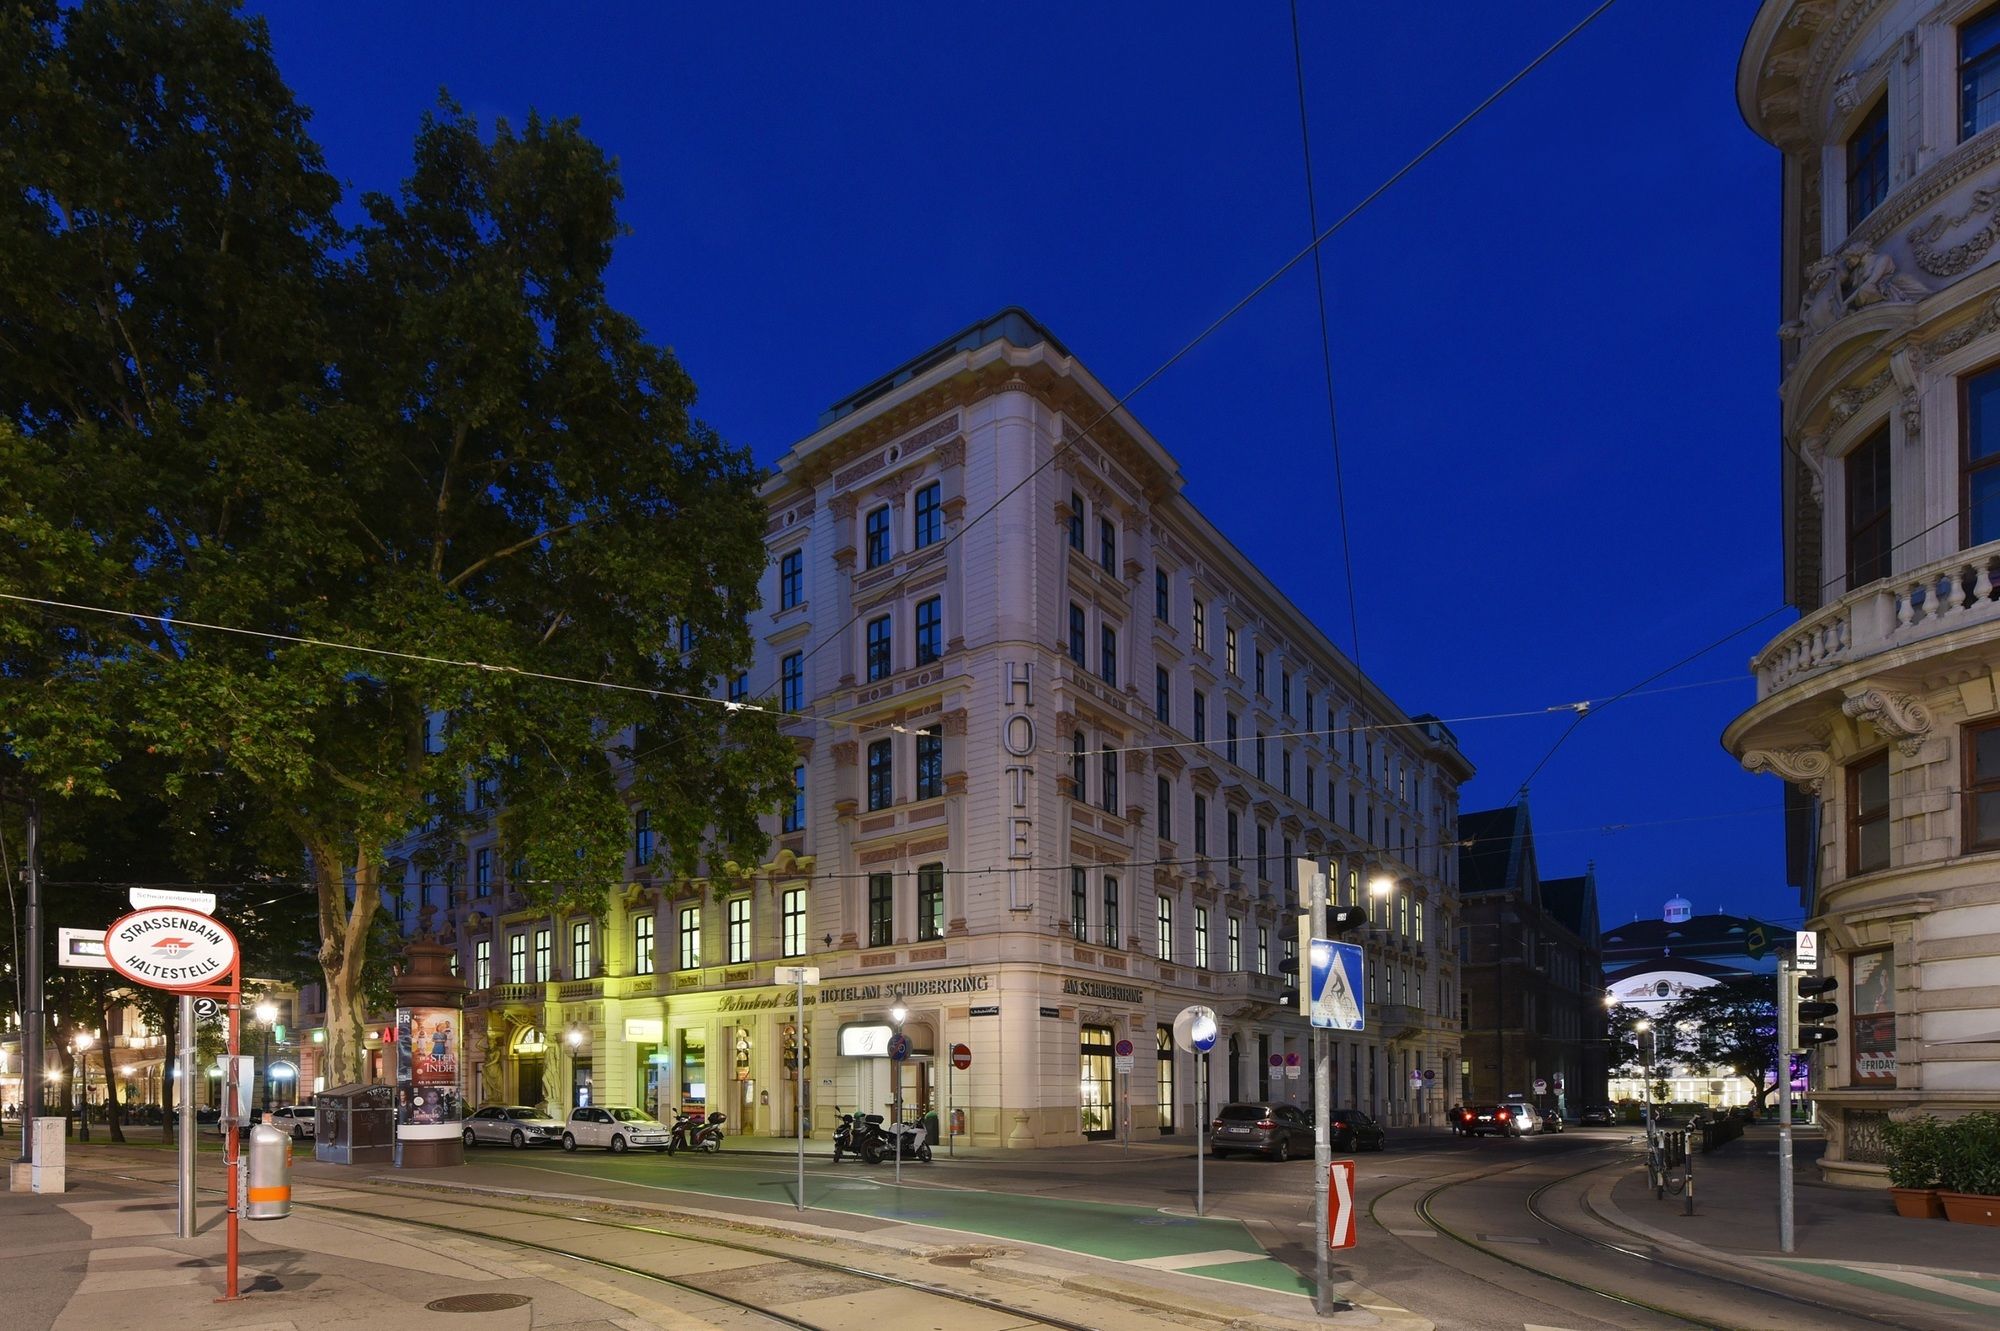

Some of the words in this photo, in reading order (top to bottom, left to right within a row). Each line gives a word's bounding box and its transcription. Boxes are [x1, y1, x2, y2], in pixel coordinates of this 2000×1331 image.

[1003, 662, 1038, 912] HOTEL
[120, 917, 224, 945] STRASSENBAHN
[125, 955, 220, 979] HALTESTELLE
[819, 986, 859, 1003] HOTEL
[859, 985, 880, 1000] AM
[884, 975, 988, 998] SCHUBERTRING
[1079, 981, 1143, 1003] SCHUBERTRING
[199, 1002, 212, 1014] 2
[717, 993, 781, 1012] Schubert
